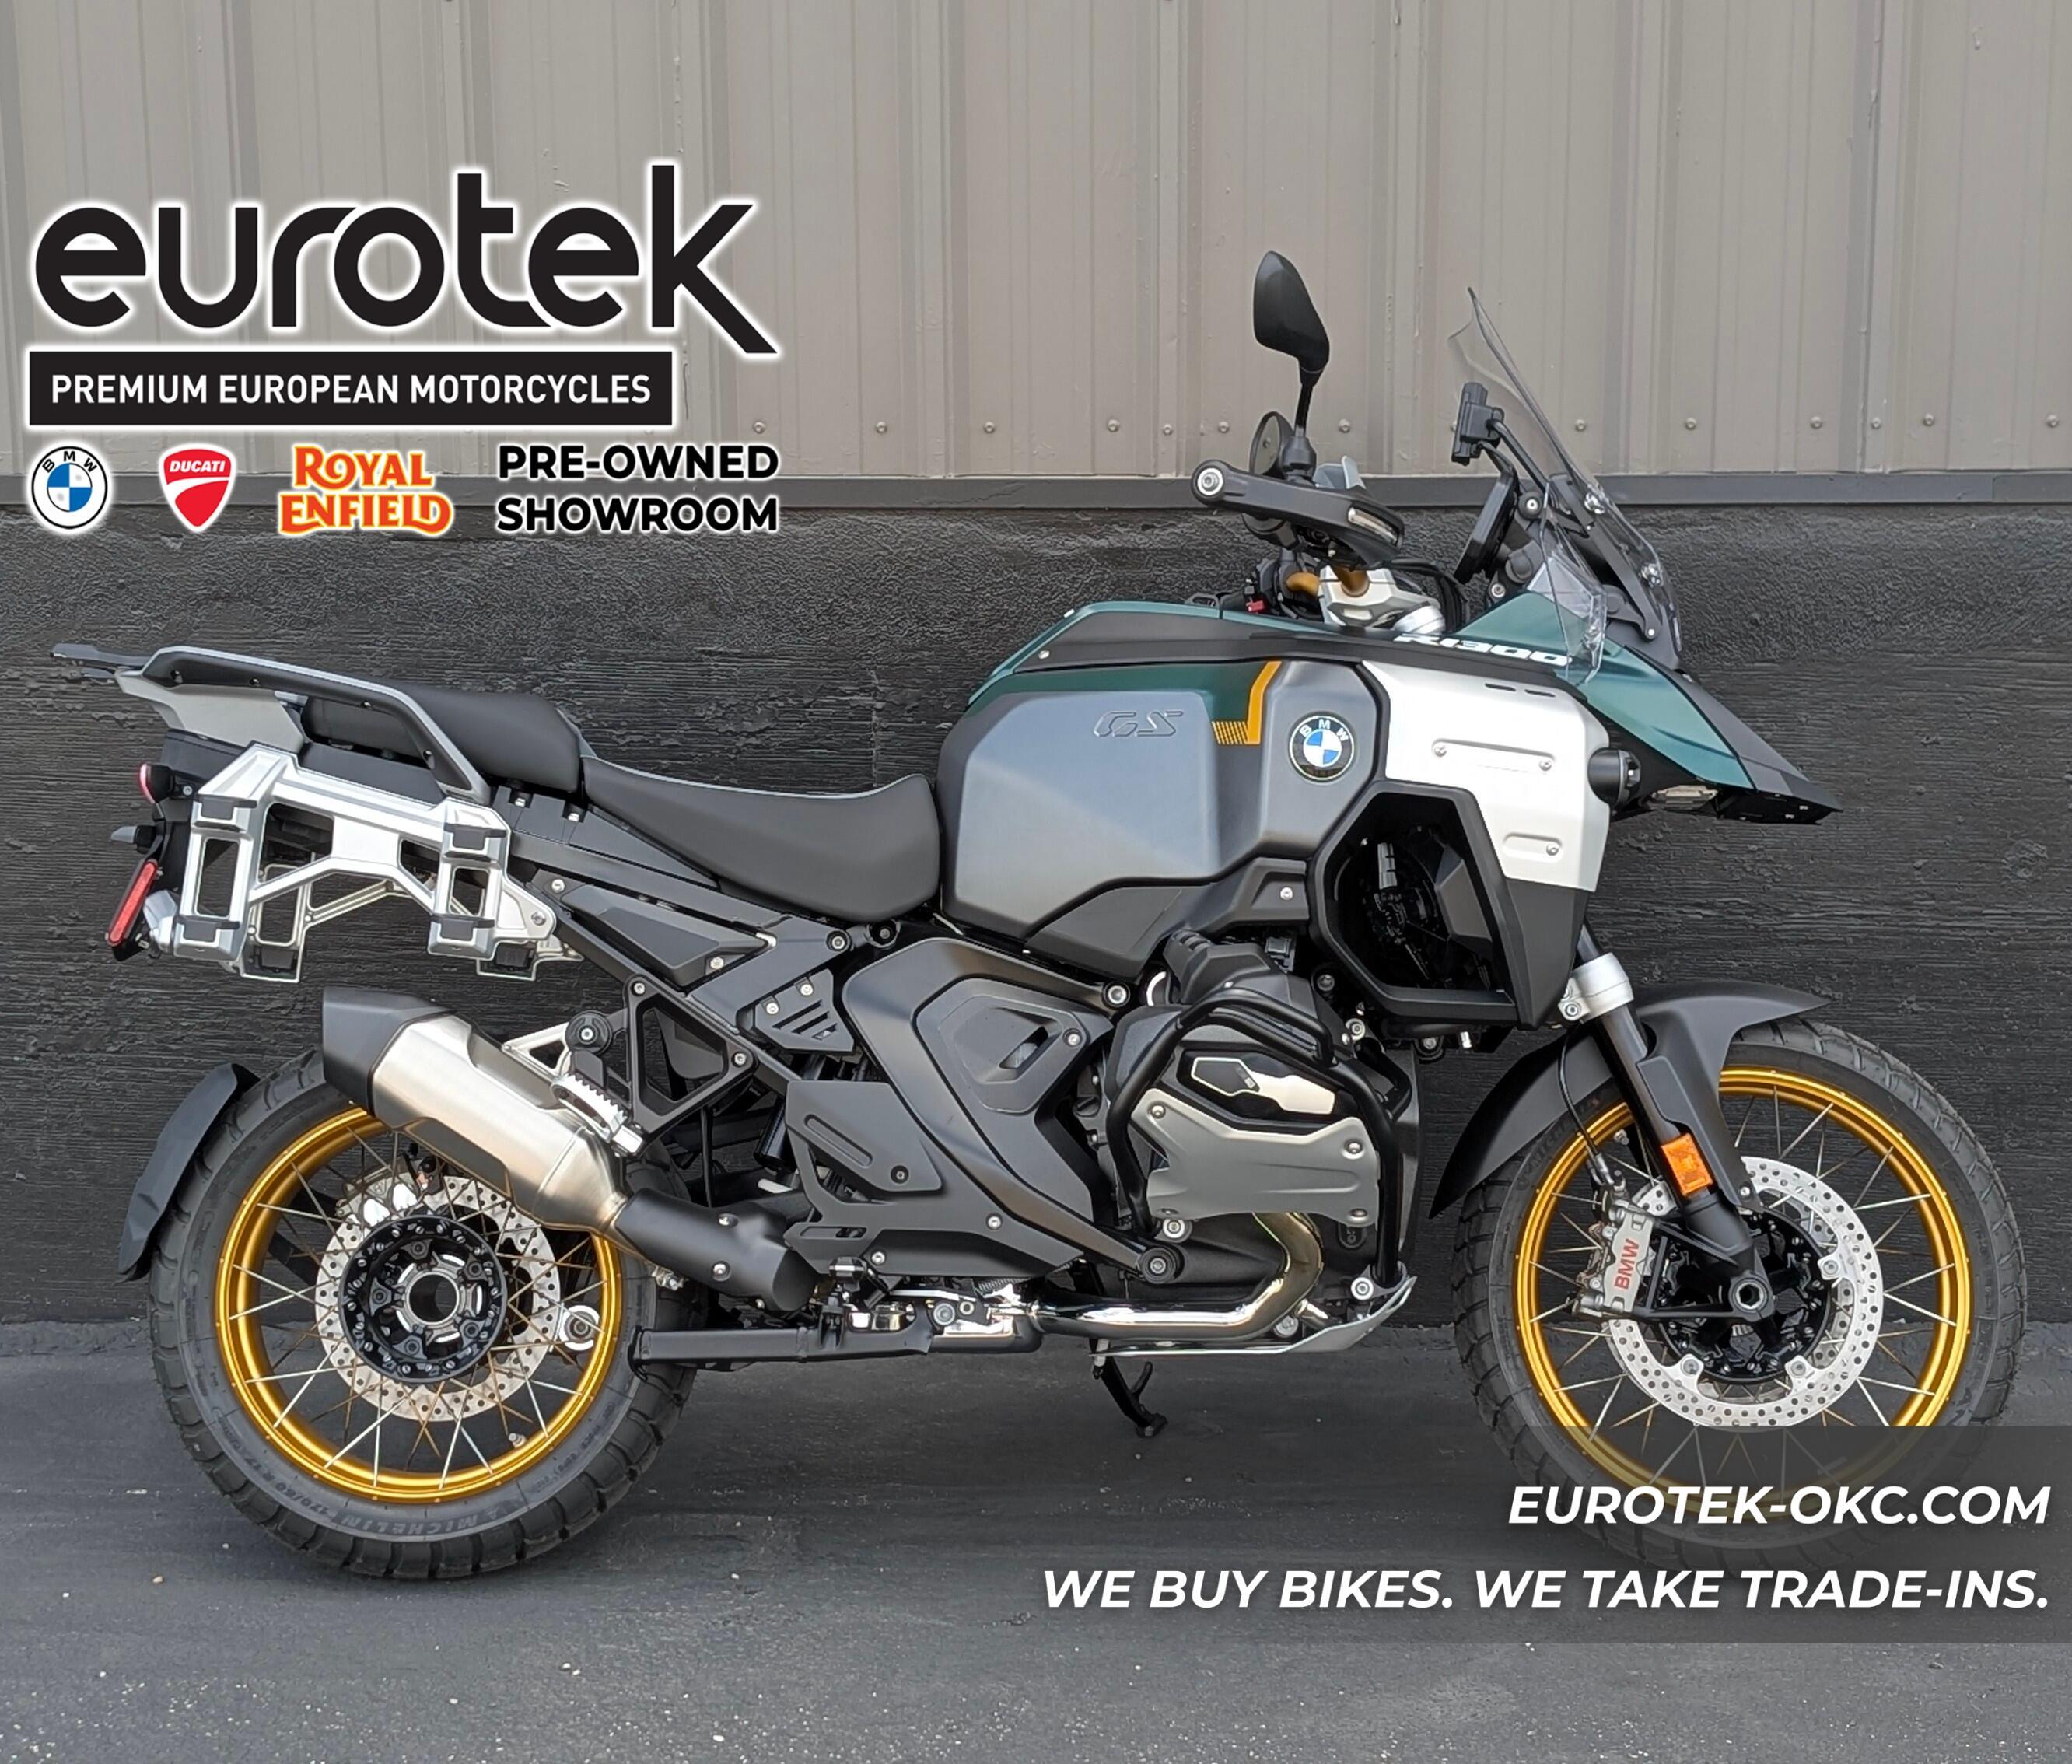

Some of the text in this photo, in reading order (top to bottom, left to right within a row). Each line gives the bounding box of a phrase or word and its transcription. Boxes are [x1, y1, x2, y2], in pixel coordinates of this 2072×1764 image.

[1094, 710, 1184, 737] GS
[1299, 719, 1349, 741] BMW
[1614, 1238, 1639, 1290] BMW
[341, 1514, 478, 1535] MICHELIN
